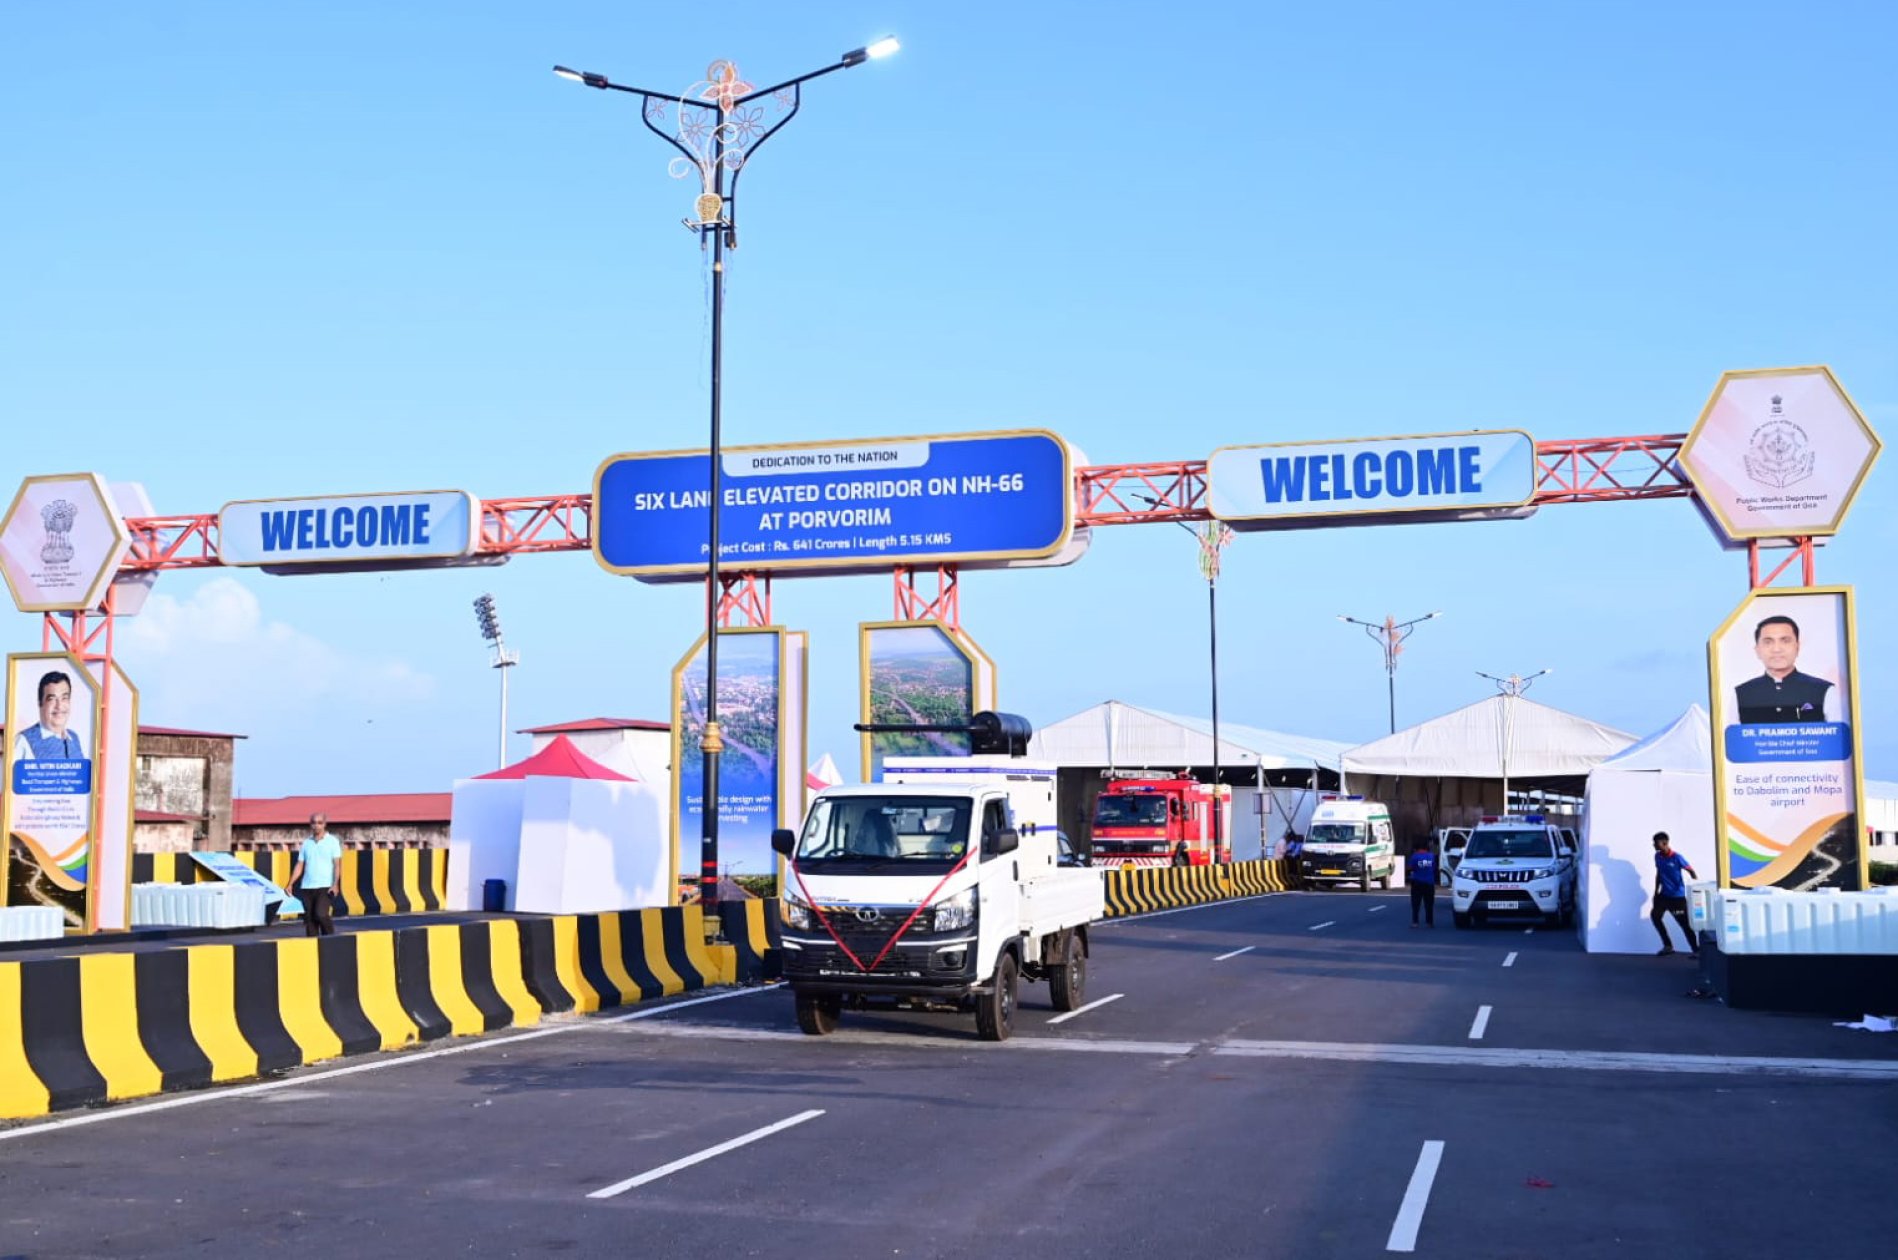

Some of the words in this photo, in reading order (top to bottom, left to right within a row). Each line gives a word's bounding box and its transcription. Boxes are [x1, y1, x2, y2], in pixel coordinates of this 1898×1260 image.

[752, 455, 815, 468] DEDICATION
[818, 454, 831, 465] TO
[835, 453, 854, 464] THE
[858, 451, 898, 463] NATION
[1260, 446, 1483, 504] WELCOME
[635, 493, 665, 511] SIX
[724, 484, 820, 506] ELEVATED
[824, 479, 923, 501] CORRIDOR
[927, 478, 957, 496] ON
[962, 474, 1024, 494] NH-66
[1786, 494, 1828, 502] Department
[758, 513, 784, 531] AT
[789, 508, 892, 529] PORVORIM
[261, 503, 431, 552] WELCOME
[701, 542, 740, 557] Pject
[742, 541, 767, 553] Cost
[774, 541, 790, 551] Rs.
[793, 539, 812, 551] 641
[815, 538, 851, 550] Crores
[860, 536, 897, 550] Length
[900, 534, 923, 547] 5.15
[925, 532, 952, 545] KMS
[1741, 728, 1757, 737] DR.
[1759, 727, 1798, 737] PRAMOD
[1800, 727, 1838, 736] SAWANT
[1735, 774, 1760, 784] Ease
[1762, 774, 1773, 784] of
[1775, 774, 1838, 784] connectivity
[1734, 787, 1744, 795] to
[1747, 786, 1789, 796] Dabolim
[1791, 786, 1810, 795] and
[1814, 786, 1843, 797] Mopa
[730, 795, 754, 805] design
[755, 795, 771, 803] with
[1770, 798, 1805, 809] airport
